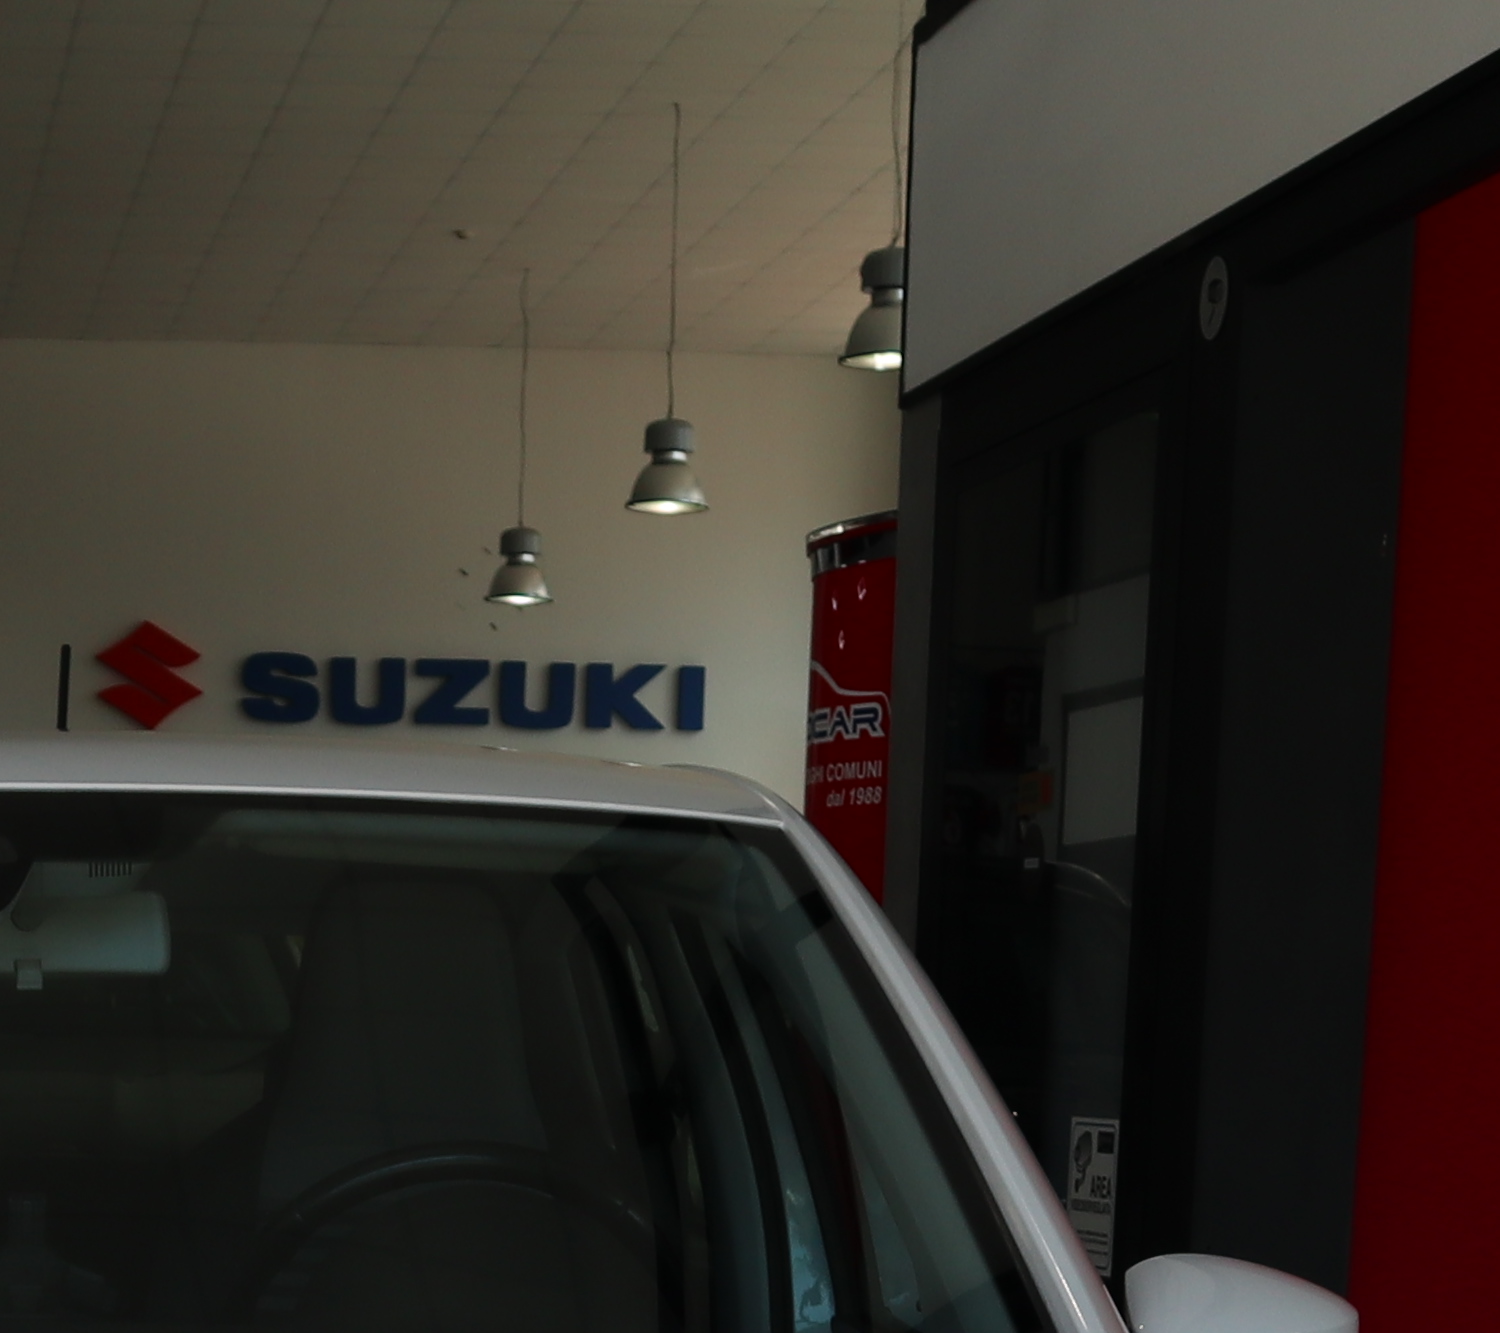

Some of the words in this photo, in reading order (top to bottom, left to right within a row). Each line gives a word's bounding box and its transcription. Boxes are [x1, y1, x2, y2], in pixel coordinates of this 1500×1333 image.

[240, 651, 707, 732] SUZUKI
[808, 701, 886, 746] CAR
[825, 759, 883, 782] COMUNI
[826, 787, 845, 808] dal
[848, 786, 883, 807] 1988
[1090, 1175, 1112, 1200] AREA
